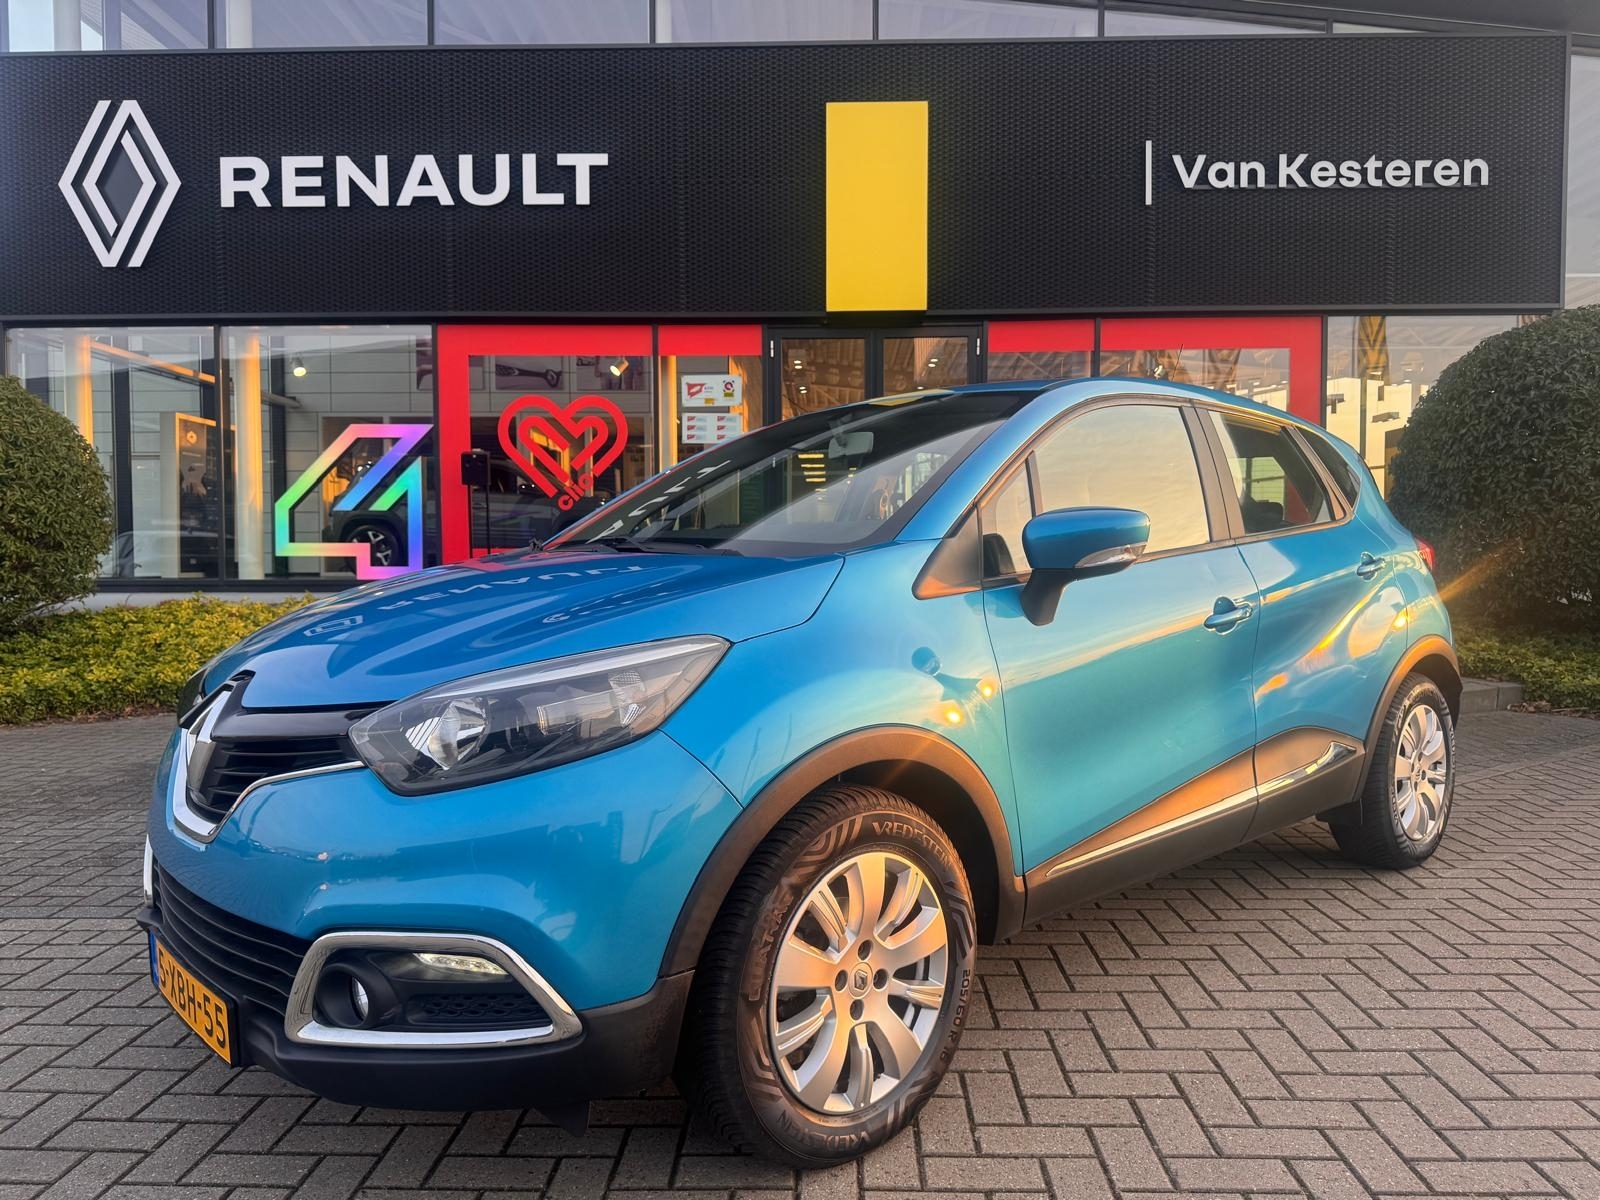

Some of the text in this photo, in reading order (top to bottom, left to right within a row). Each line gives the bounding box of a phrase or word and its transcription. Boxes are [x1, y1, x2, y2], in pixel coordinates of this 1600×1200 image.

[219, 152, 609, 208] RENAULT
[1171, 153, 1490, 189] Van Kesteren
[558, 473, 594, 511] clio
[872, 820, 953, 870] VREDESTEIN
[158, 947, 226, 1049] 5-XBH-55
[953, 969, 971, 1027] 205/60
[948, 1030, 959, 1042] R
